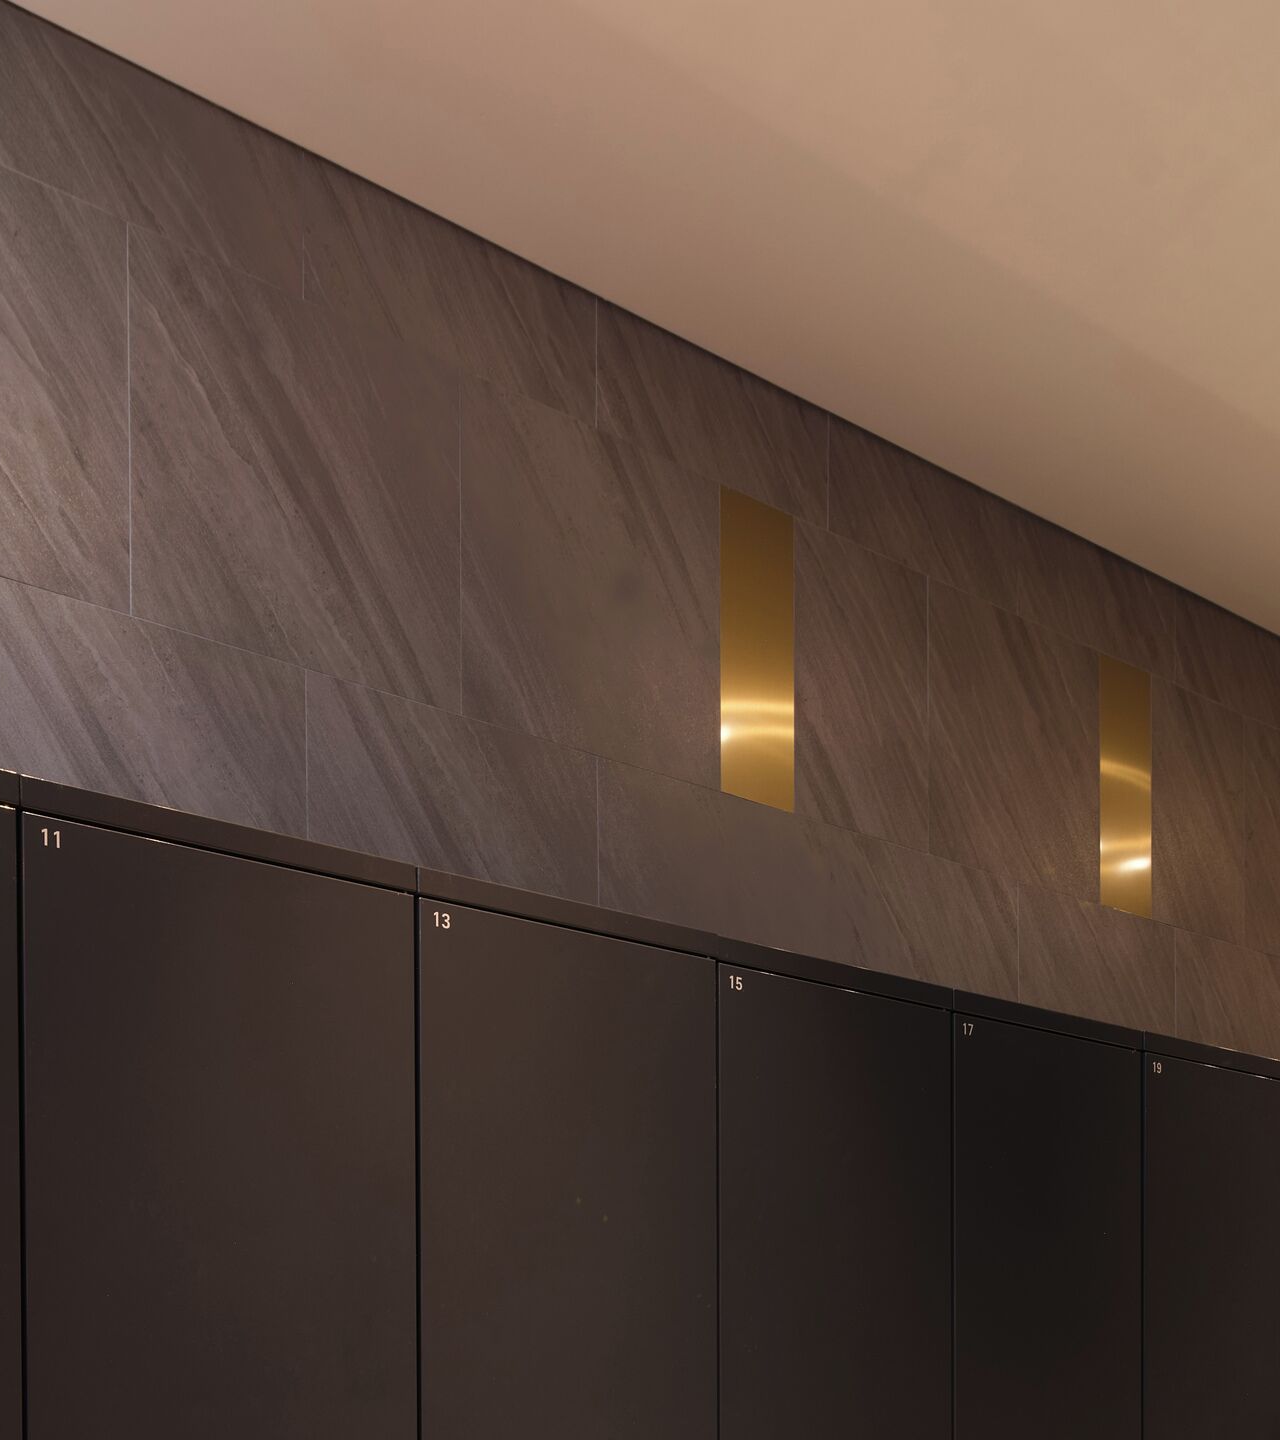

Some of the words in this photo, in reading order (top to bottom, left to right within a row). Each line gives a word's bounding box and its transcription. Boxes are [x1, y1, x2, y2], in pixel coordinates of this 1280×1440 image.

[41, 828, 61, 849] 11
[433, 911, 451, 929] 13
[729, 975, 743, 991] 15
[962, 1022, 974, 1036] 17
[1152, 1061, 1163, 1074] 19
